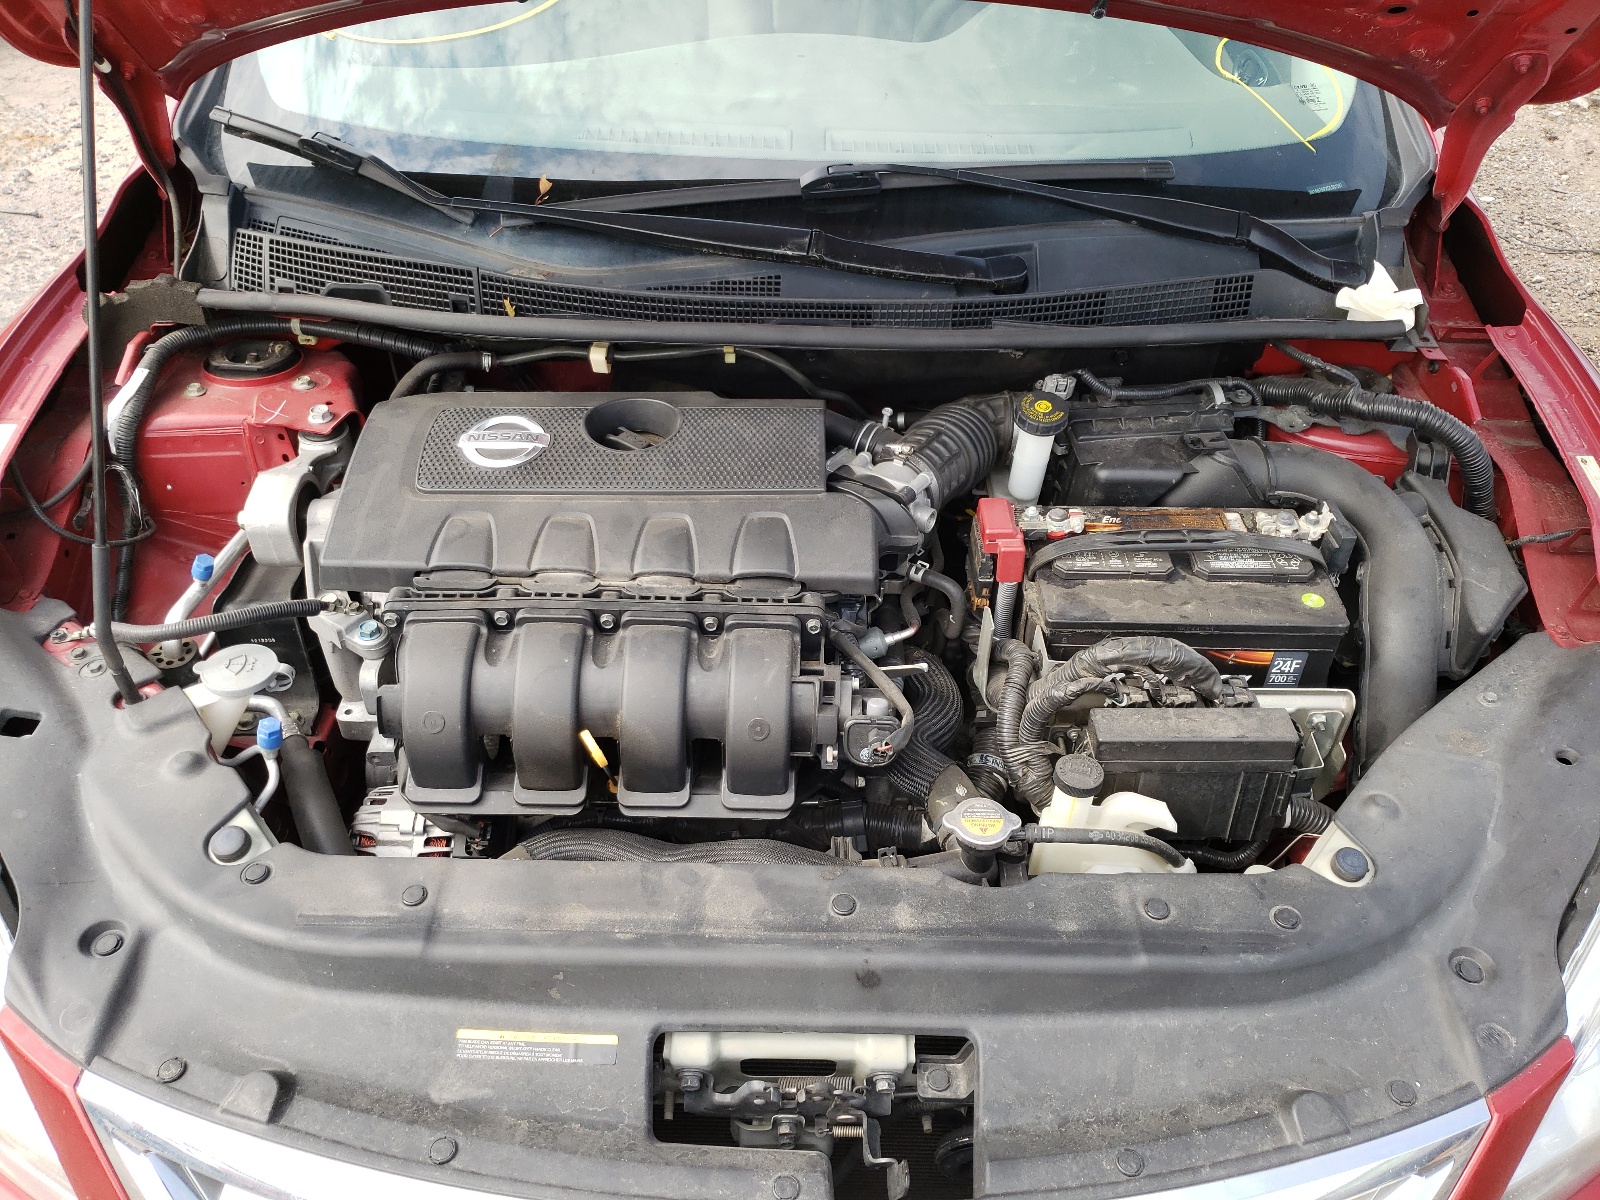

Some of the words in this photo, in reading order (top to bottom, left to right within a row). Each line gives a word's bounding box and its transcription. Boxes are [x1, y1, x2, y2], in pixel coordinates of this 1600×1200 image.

[467, 432, 540, 442] NISSAN
[1271, 660, 1302, 673] 24F
[1269, 675, 1287, 683] 700
